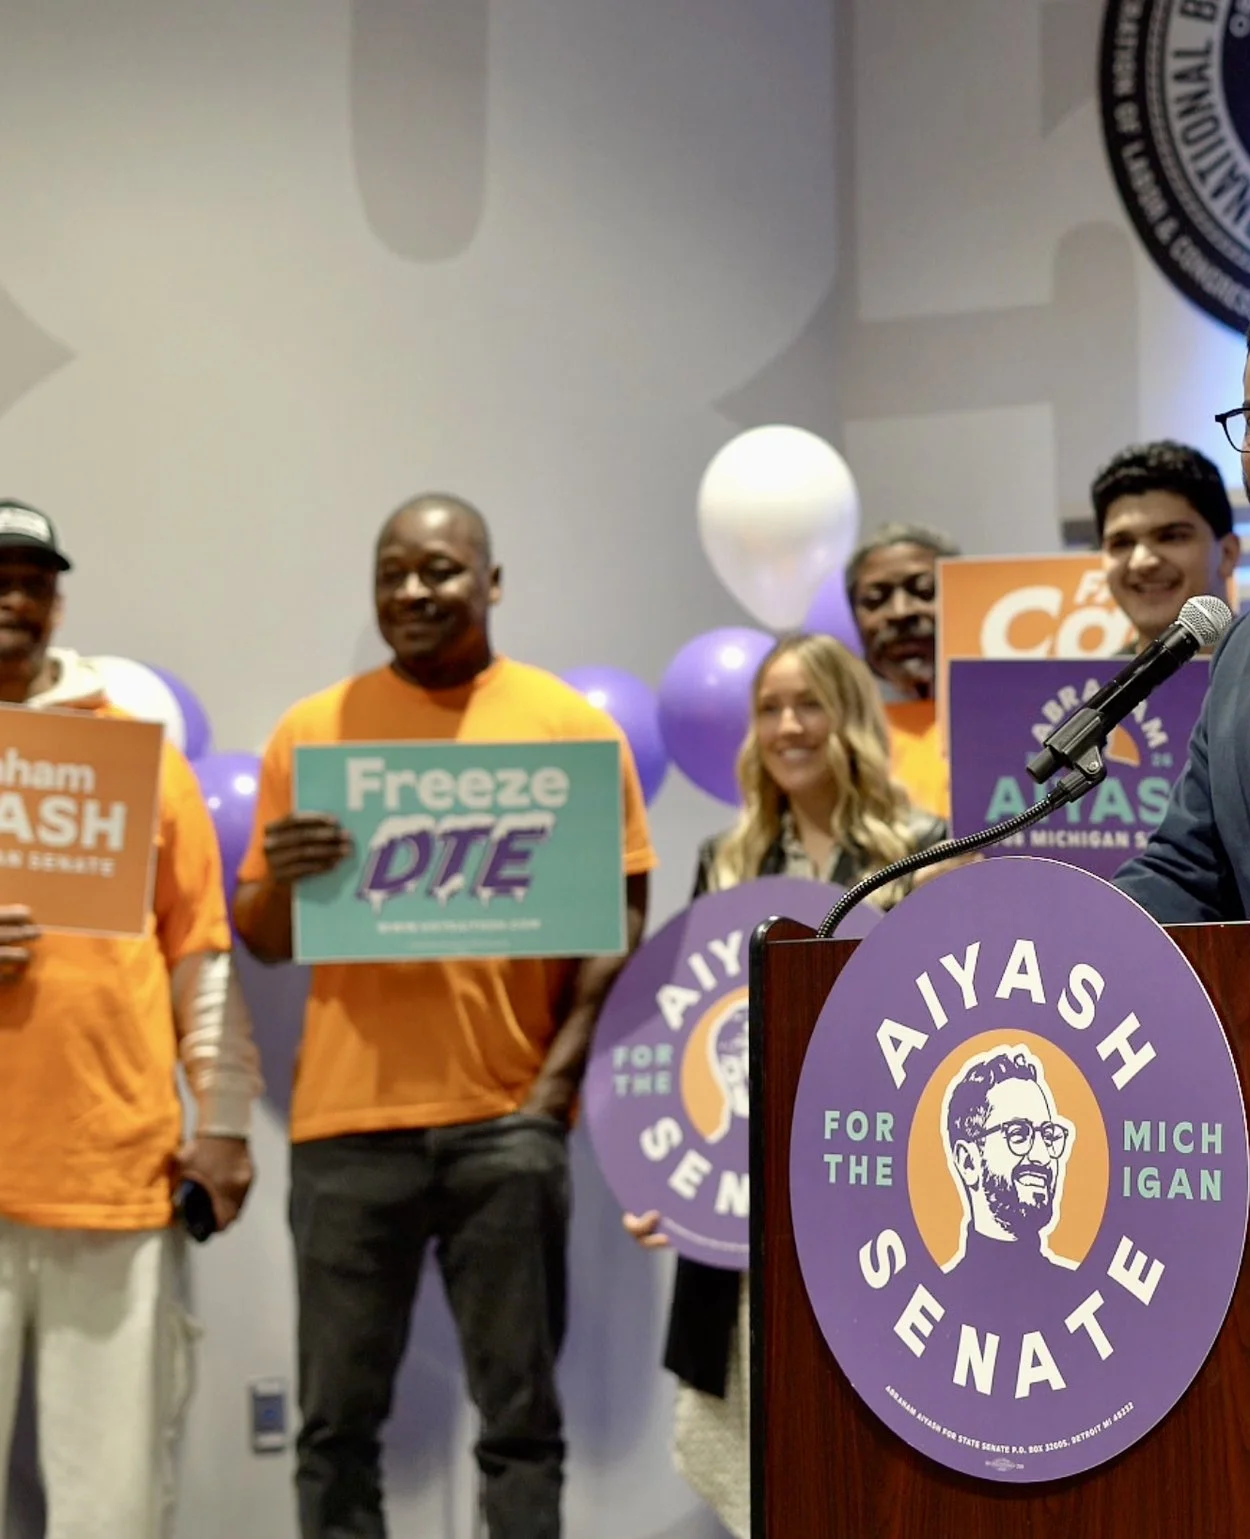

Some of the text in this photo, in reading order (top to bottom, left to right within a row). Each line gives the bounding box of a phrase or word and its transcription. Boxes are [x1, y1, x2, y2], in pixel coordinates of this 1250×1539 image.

[345, 756, 570, 811] Freeze
[355, 811, 556, 910] DTE
[1030, 829, 1130, 849] MICHIGAN
[875, 938, 1158, 1090] AIYASH
[612, 1043, 673, 1070] FOR
[612, 1070, 671, 1097] THE
[823, 1110, 1224, 1155] FOR MICH
[823, 1153, 1223, 1202] THE IGAN
[859, 1228, 1167, 1400] SENATE
[885, 1385, 917, 1416] ABRAHAM
[916, 1412, 942, 1433] AIYASH
[942, 1427, 957, 1441] FOR
[958, 1434, 980, 1449] STATE
[981, 1441, 1010, 1454] SENATE
[1011, 1446, 1027, 1454] P.O.
[1028, 1444, 1044, 1454] BOX
[1070, 1423, 1101, 1445] DETROIT
[1102, 1417, 1113, 1429] MI
